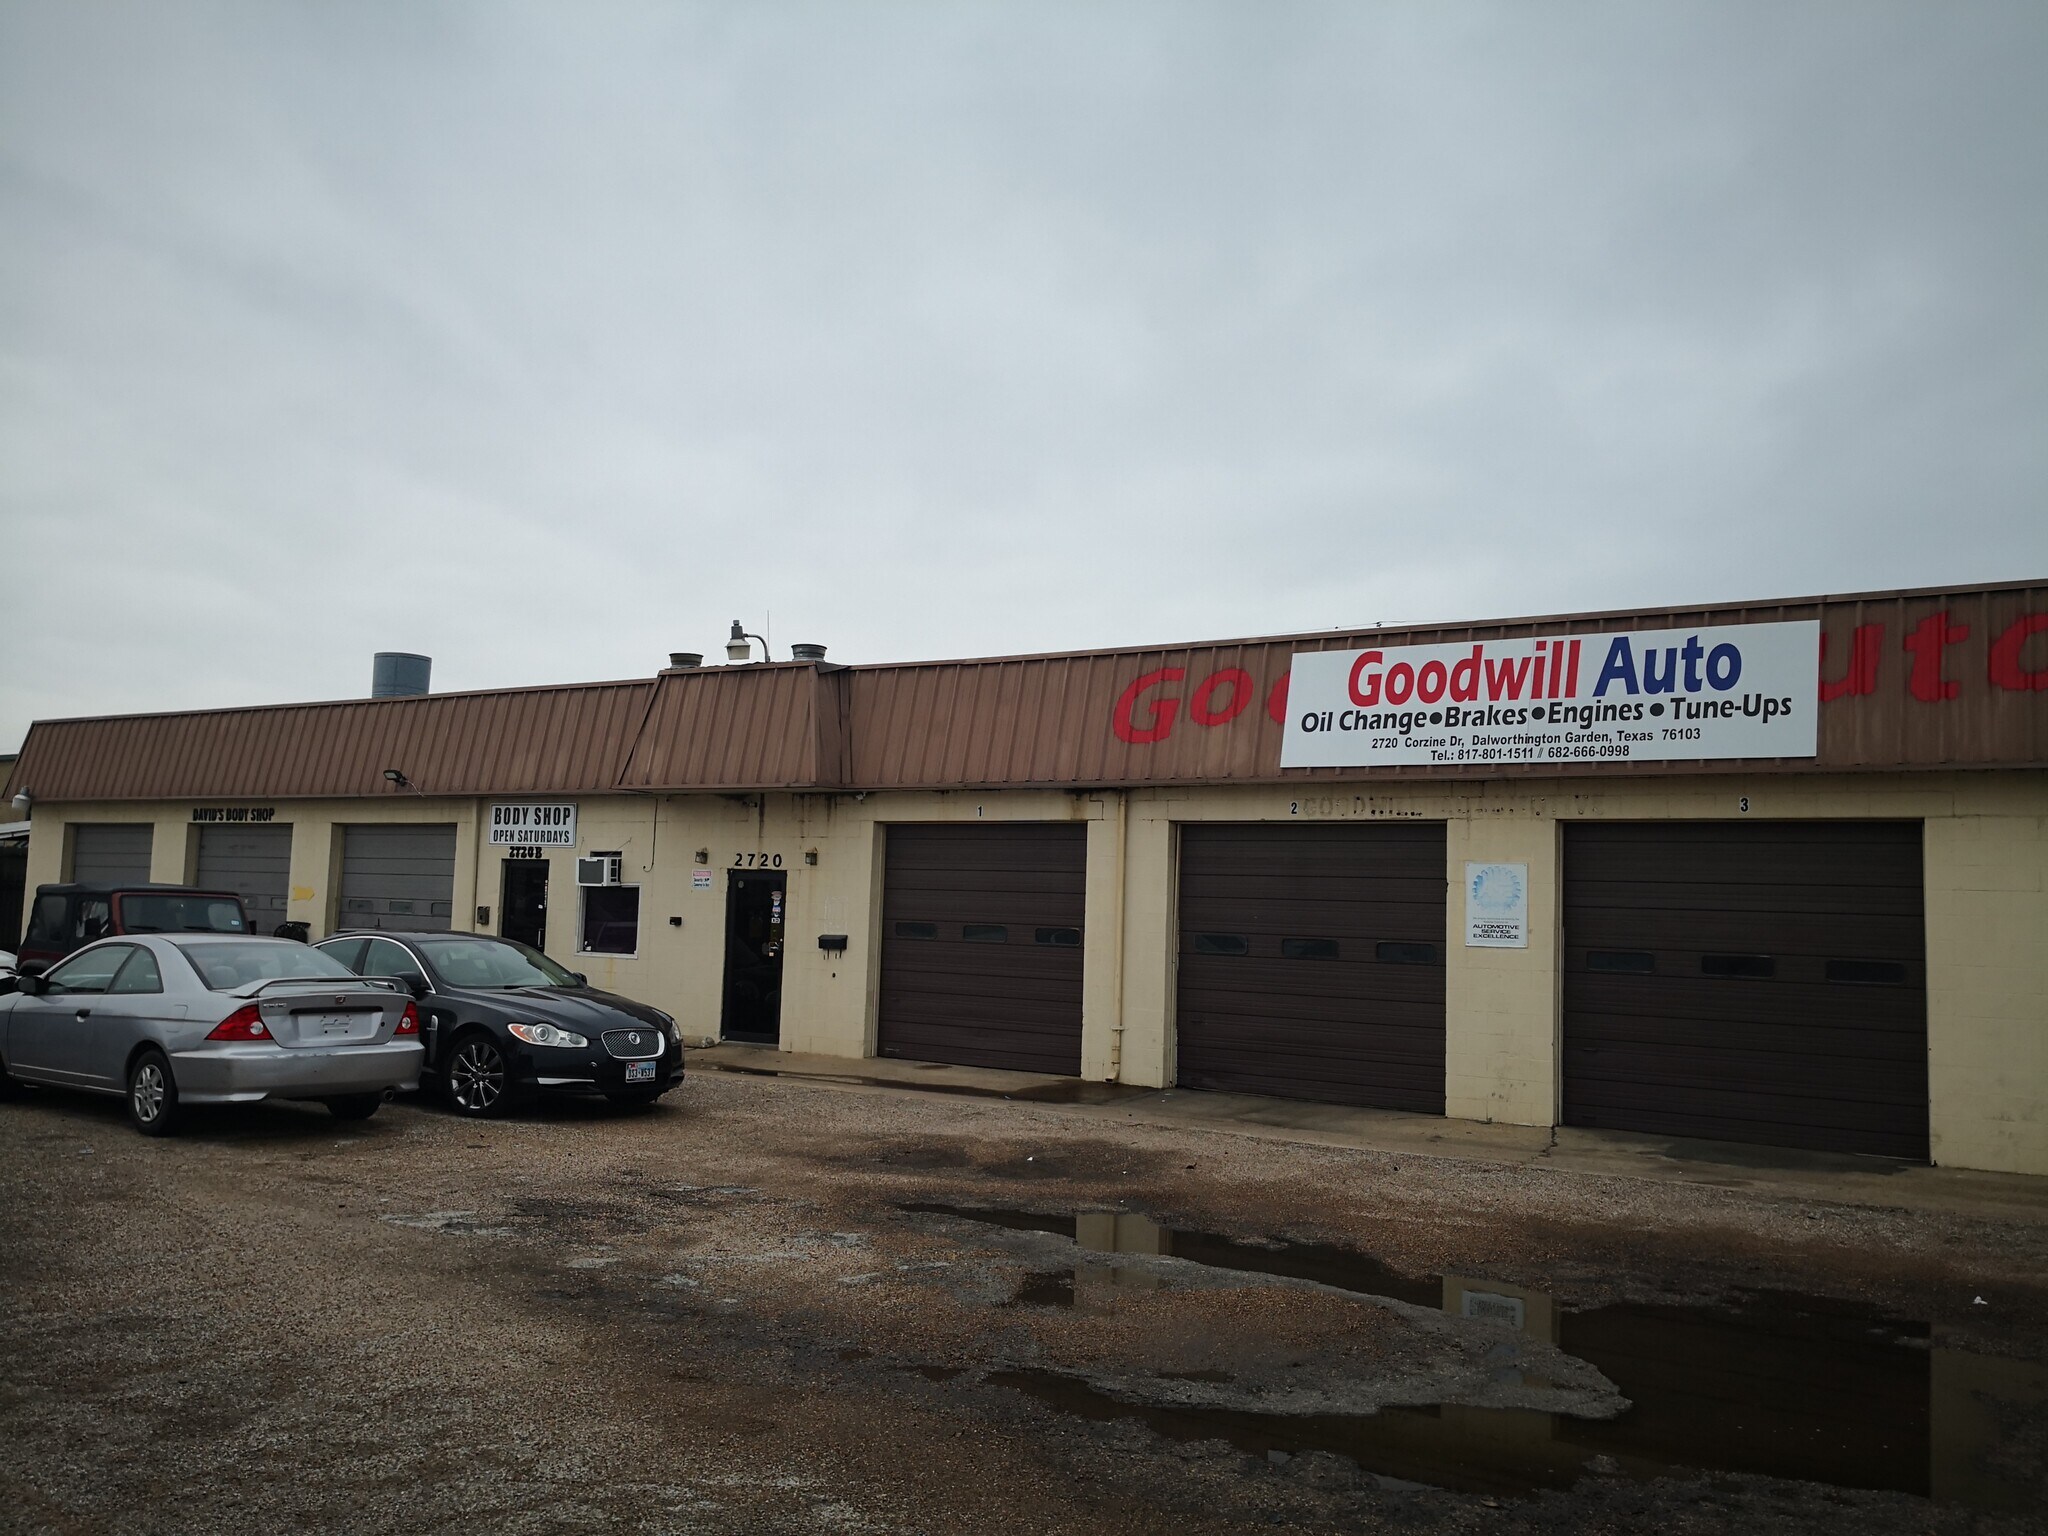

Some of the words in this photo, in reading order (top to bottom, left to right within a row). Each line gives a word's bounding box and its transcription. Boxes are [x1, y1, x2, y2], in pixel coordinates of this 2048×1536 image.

[1348, 640, 1581, 707] Goodwill
[1592, 635, 1742, 697] Auto
[1301, 711, 1333, 733] Oil
[1339, 710, 1427, 735] Change
[1444, 704, 1528, 728] Brakes
[1548, 699, 1644, 729] Engines
[1670, 693, 1792, 724] Tune-Ups
[1372, 737, 1398, 749] 2720
[1404, 737, 1446, 748] Corzine
[1450, 735, 1465, 749] Dr,
[1472, 733, 1560, 747] Dalworthington
[1565, 730, 1613, 744] Garden,
[1617, 730, 1654, 742] Texas
[1661, 728, 1701, 740] 76103
[1431, 750, 1454, 761] Tel.:
[1457, 747, 1533, 760] 817-801-1511
[1548, 745, 1630, 759] 682-666-0998
[977, 805, 982, 817] 1
[1290, 801, 1298, 815] 2
[1740, 797, 1749, 812] 3
[193, 807, 224, 822] DAVID'S
[226, 807, 249, 822] BODY
[250, 807, 275, 822] SHOP
[494, 806, 529, 825] BODY
[534, 806, 571, 826] SHOP
[493, 829, 515, 842] OPEN
[517, 829, 570, 843] SATURDAYS
[509, 845, 543, 859] 2720B
[734, 853, 782, 868] 2720
